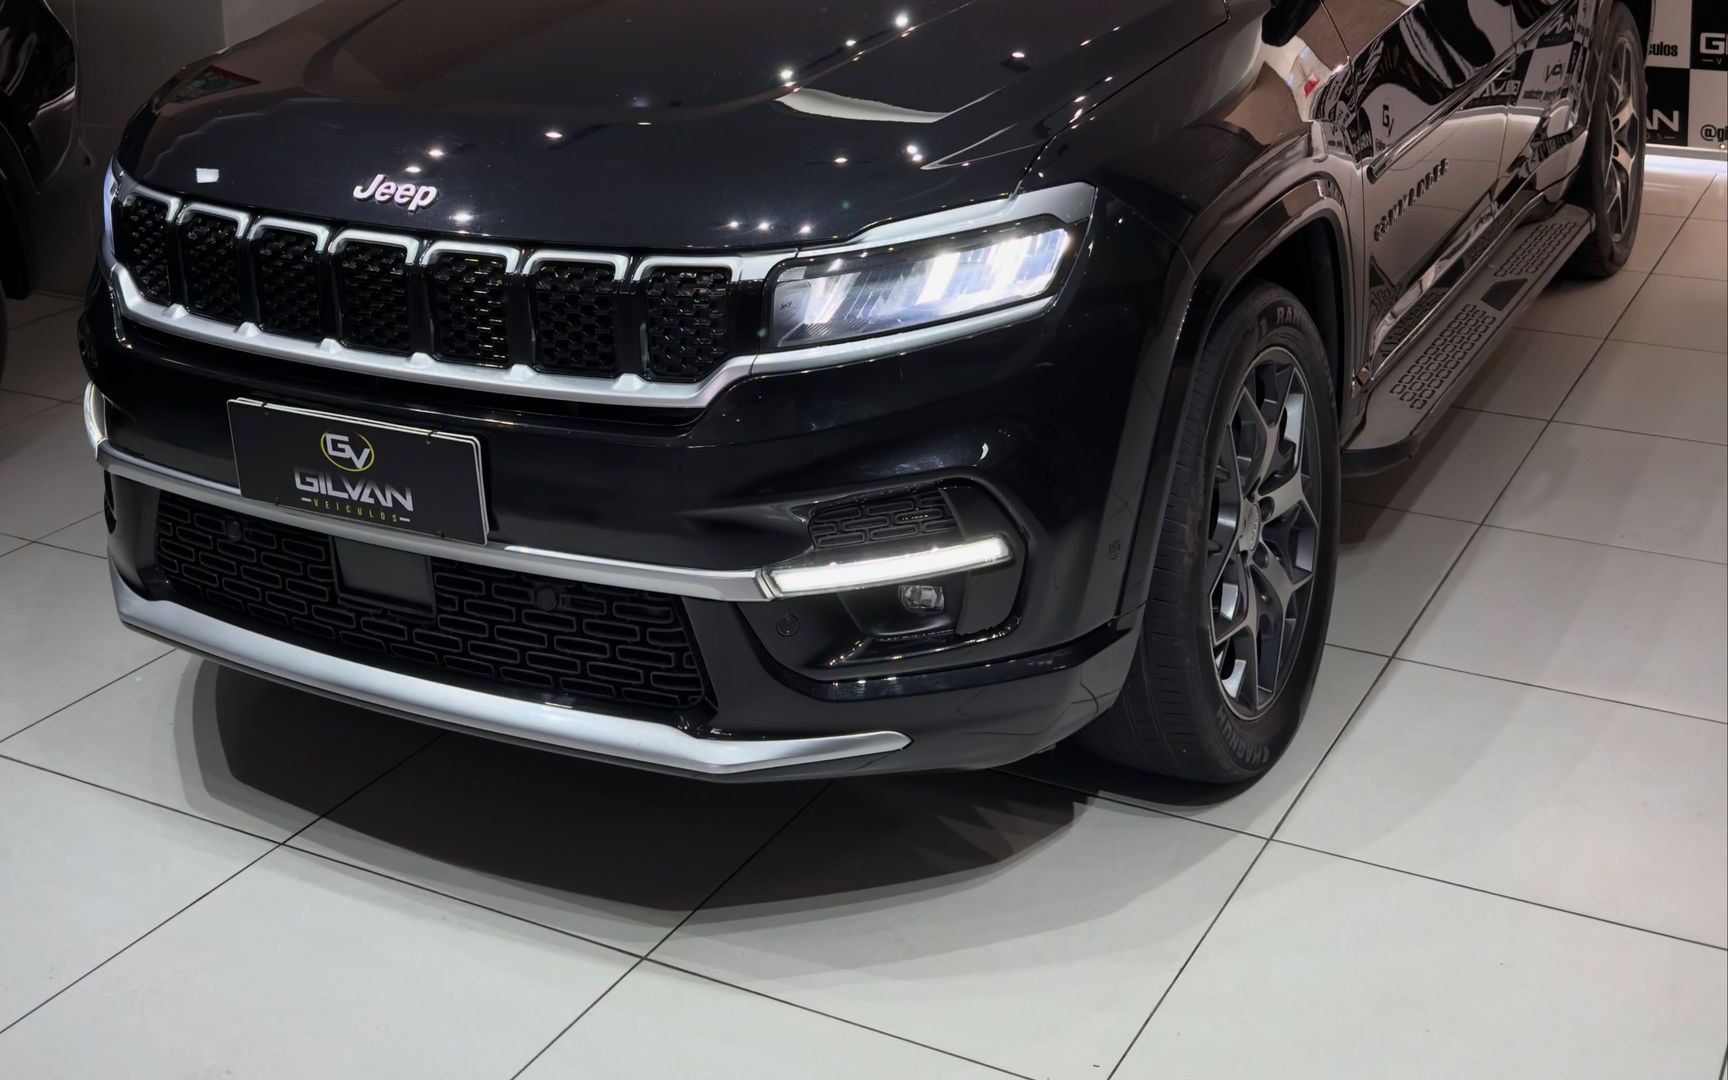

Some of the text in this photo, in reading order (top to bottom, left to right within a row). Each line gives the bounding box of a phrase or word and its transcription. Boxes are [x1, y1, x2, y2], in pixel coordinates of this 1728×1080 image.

[353, 174, 440, 214] Jeep
[324, 432, 371, 468] GV
[294, 469, 413, 512] GILVAN
